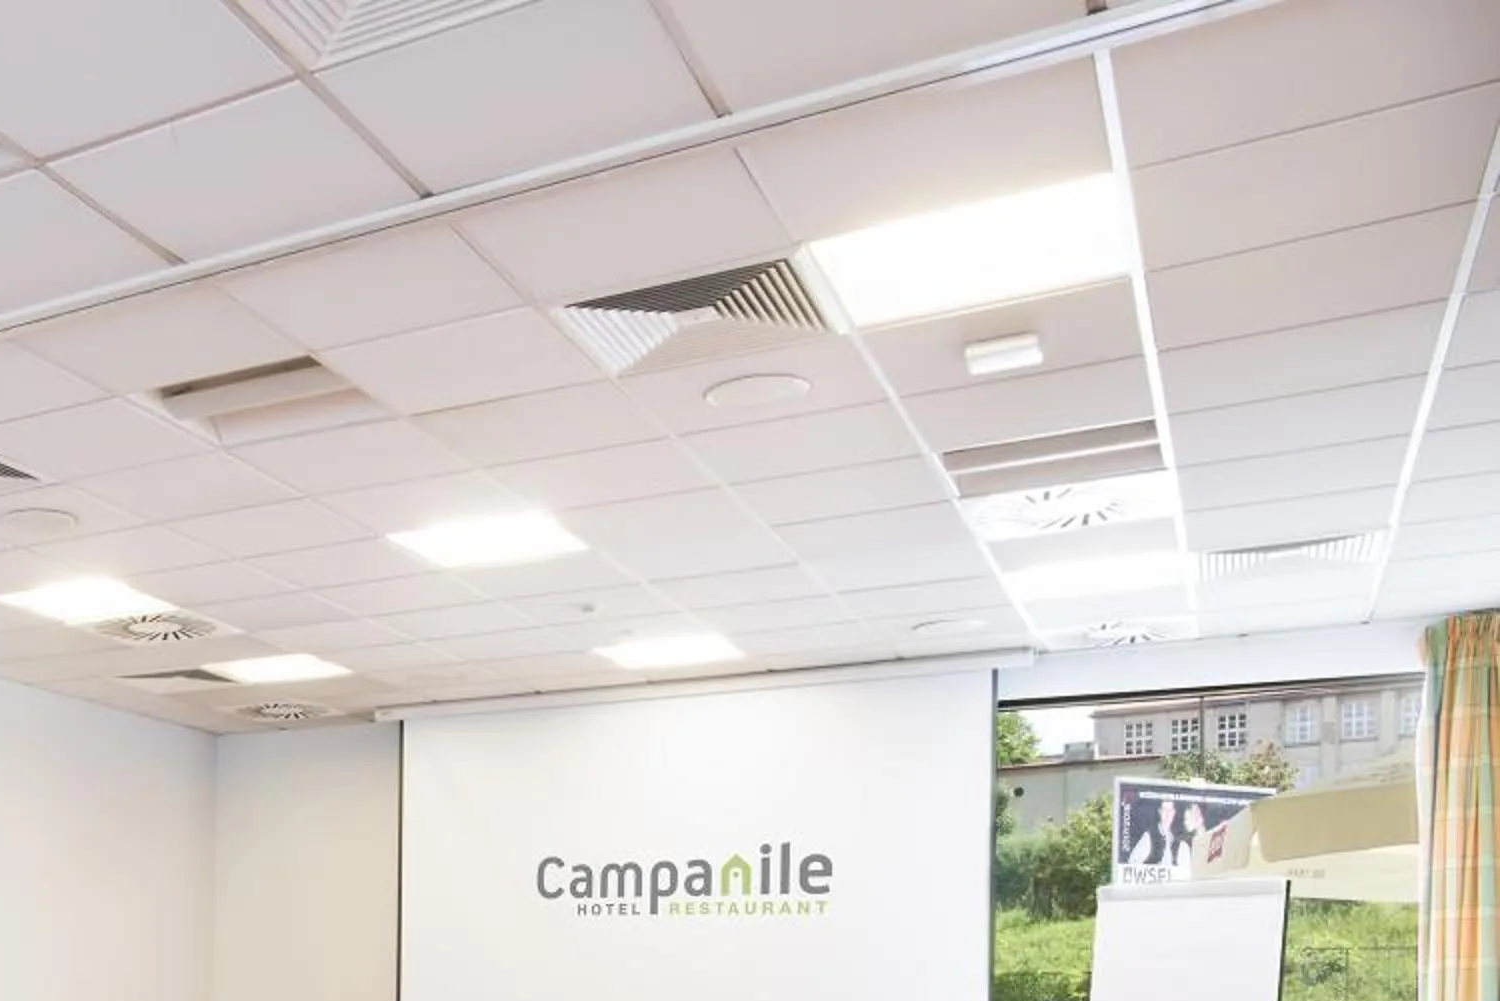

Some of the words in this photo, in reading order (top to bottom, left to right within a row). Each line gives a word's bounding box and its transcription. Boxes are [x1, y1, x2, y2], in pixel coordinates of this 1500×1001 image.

[536, 841, 834, 915] Campanile
[577, 902, 641, 916] HOTEL
[668, 900, 829, 916] RESTAURANT
